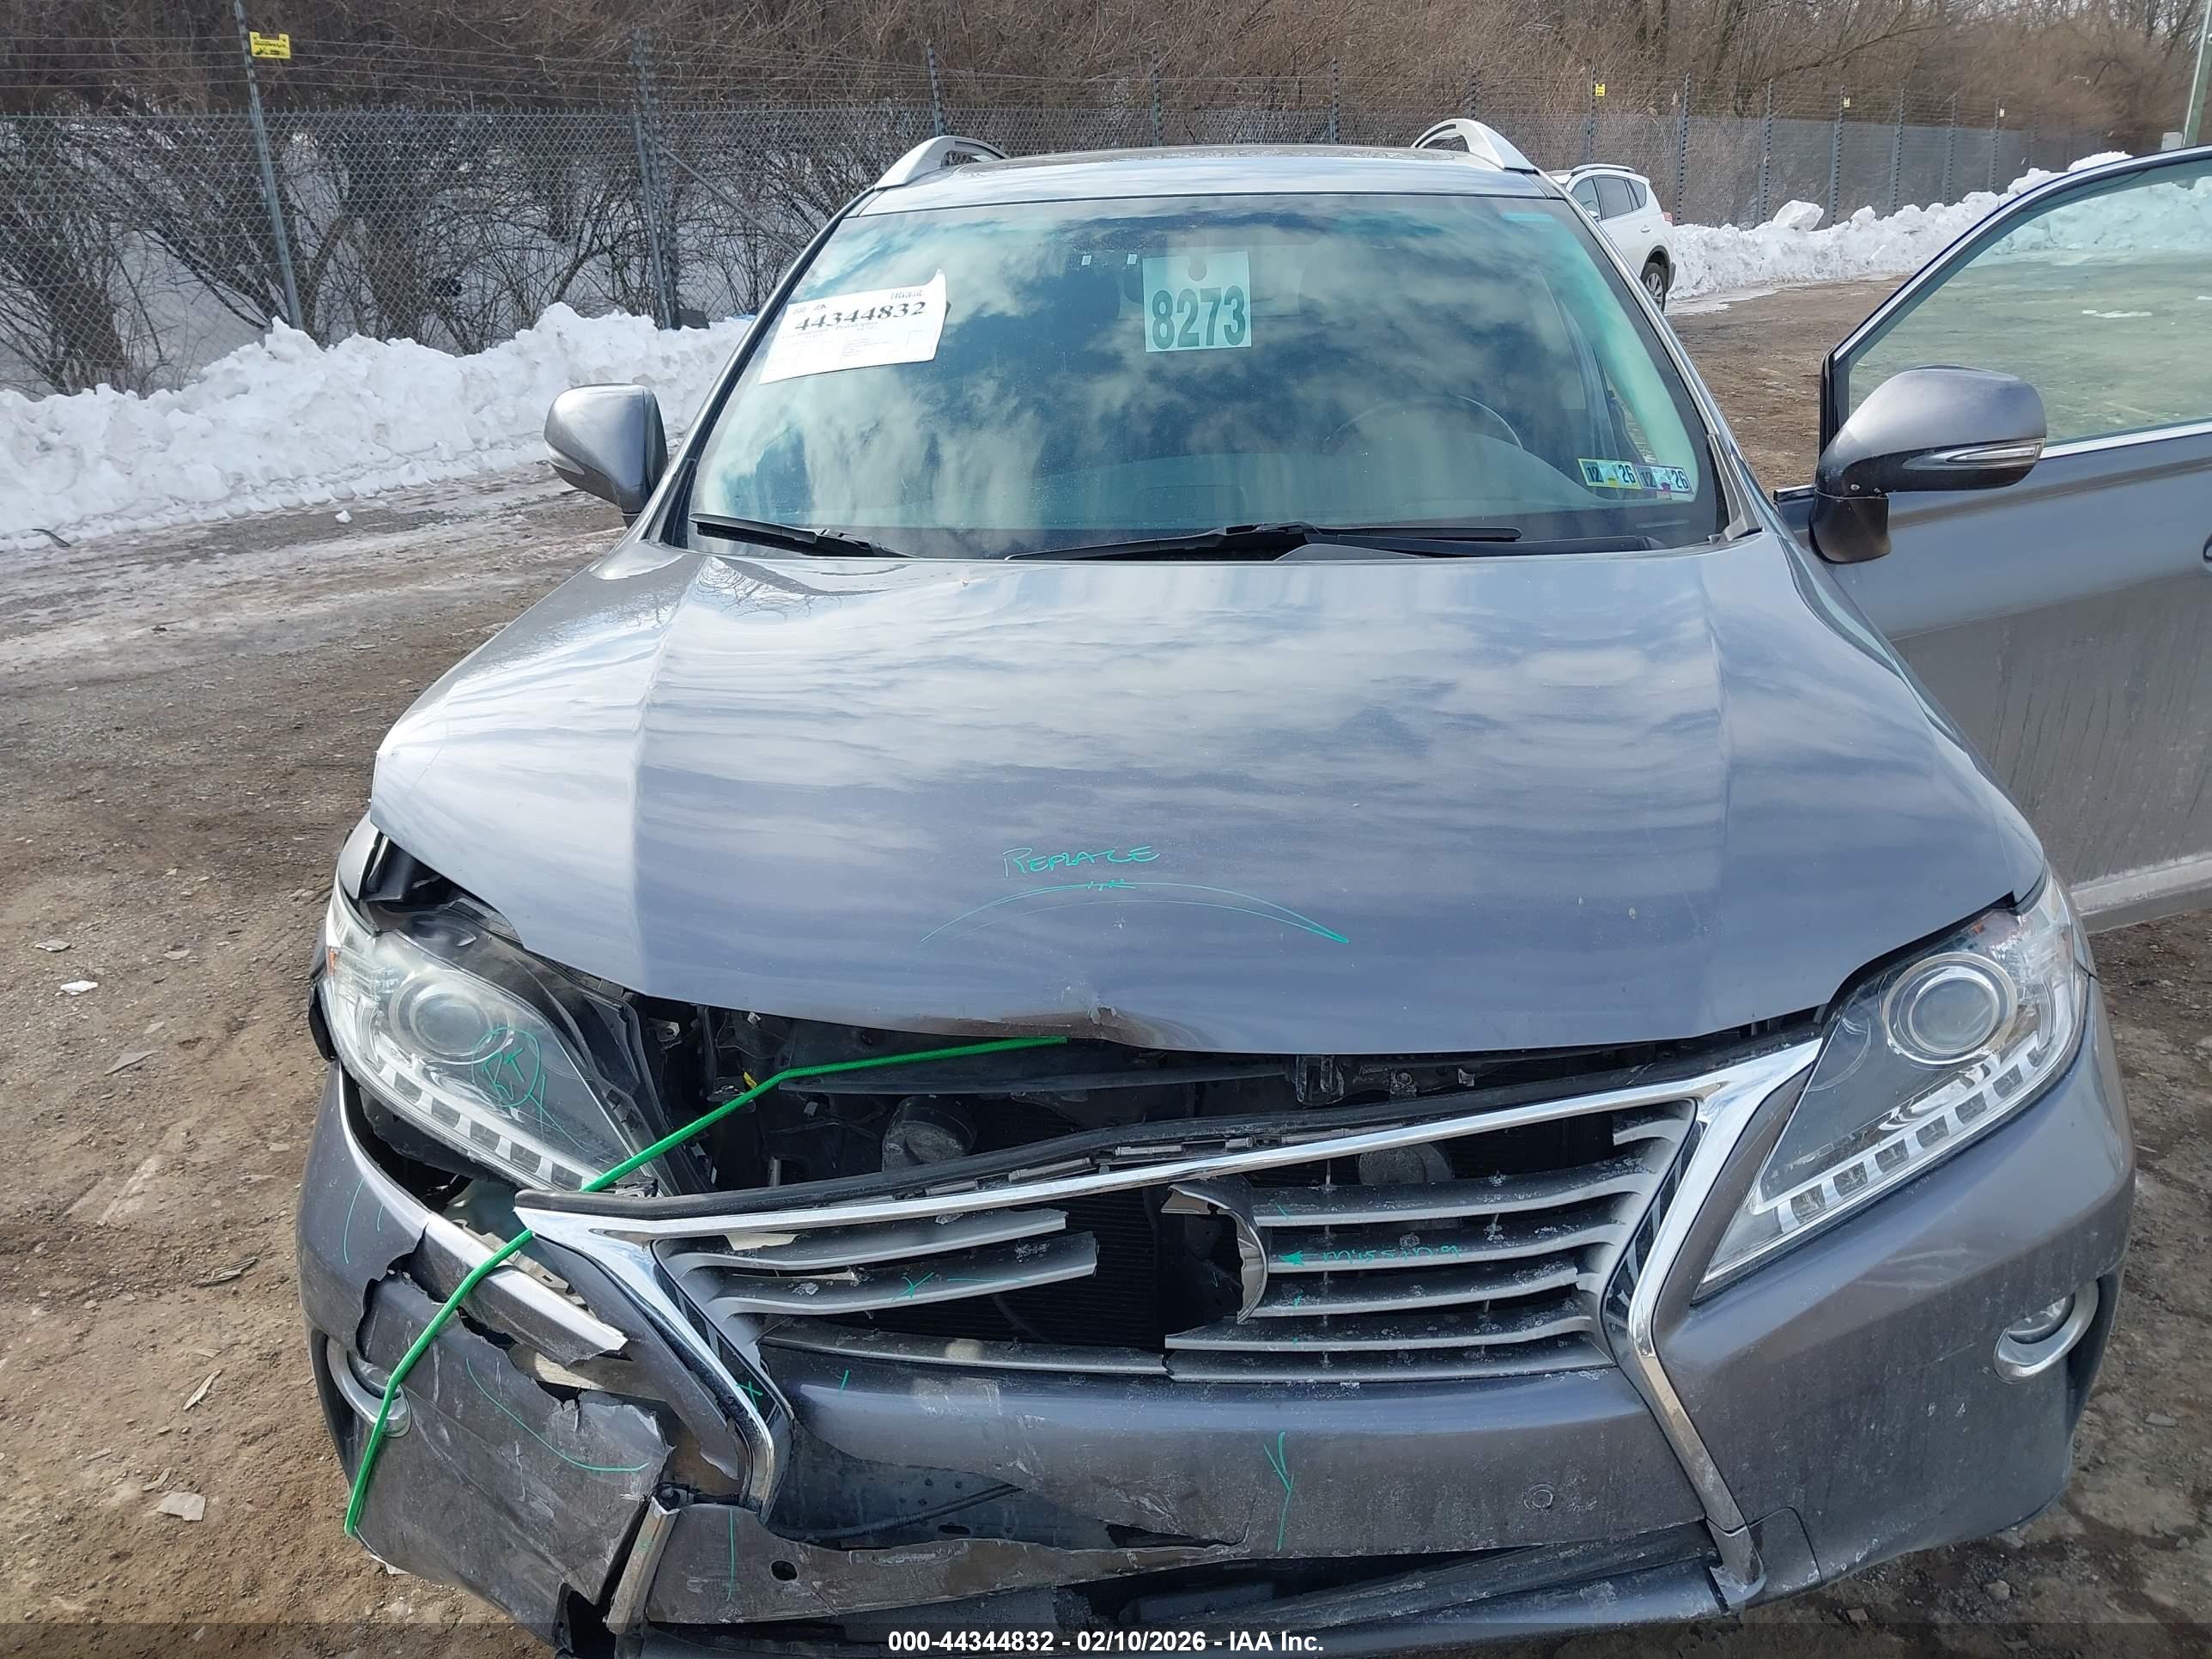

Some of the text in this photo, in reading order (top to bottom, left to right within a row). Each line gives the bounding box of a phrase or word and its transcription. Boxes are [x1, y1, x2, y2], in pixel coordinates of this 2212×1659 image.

[794, 301, 926, 330] 44344832
[1152, 285, 1246, 349] 8273
[1587, 465, 1636, 483] 12 26
[1640, 470, 1689, 489] 12 26
[1002, 846, 1160, 878] REPLACE
[1322, 1244, 1462, 1264] missing
